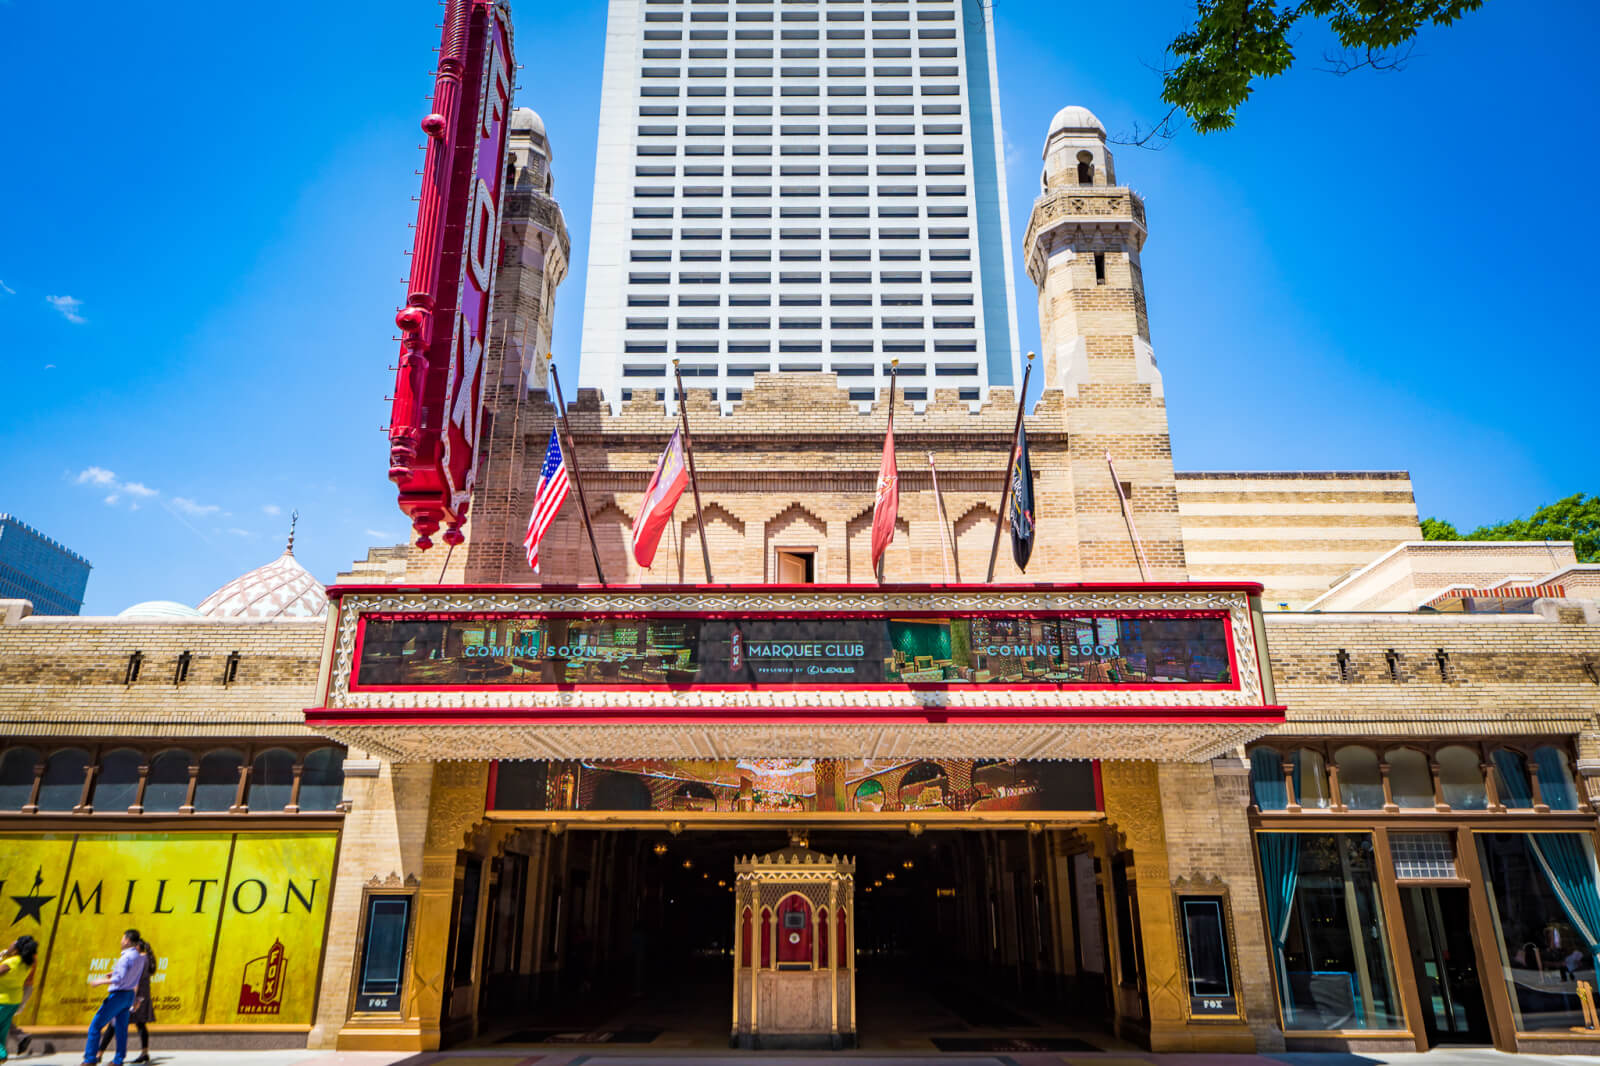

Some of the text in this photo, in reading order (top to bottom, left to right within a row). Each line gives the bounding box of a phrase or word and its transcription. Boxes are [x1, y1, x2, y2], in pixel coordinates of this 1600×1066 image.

[452, 39, 511, 448] FOX
[465, 646, 597, 657] COMING SOON
[732, 634, 740, 666] FOX
[748, 645, 865, 658] MARQUEE CLUB
[987, 645, 1120, 656] COMING SOON
[820, 666, 855, 674] LEXUS
[90, 958, 111, 971] MAY
[264, 949, 280, 994] FOX
[368, 998, 388, 1008] FOX
[1203, 999, 1223, 1009] FOX
